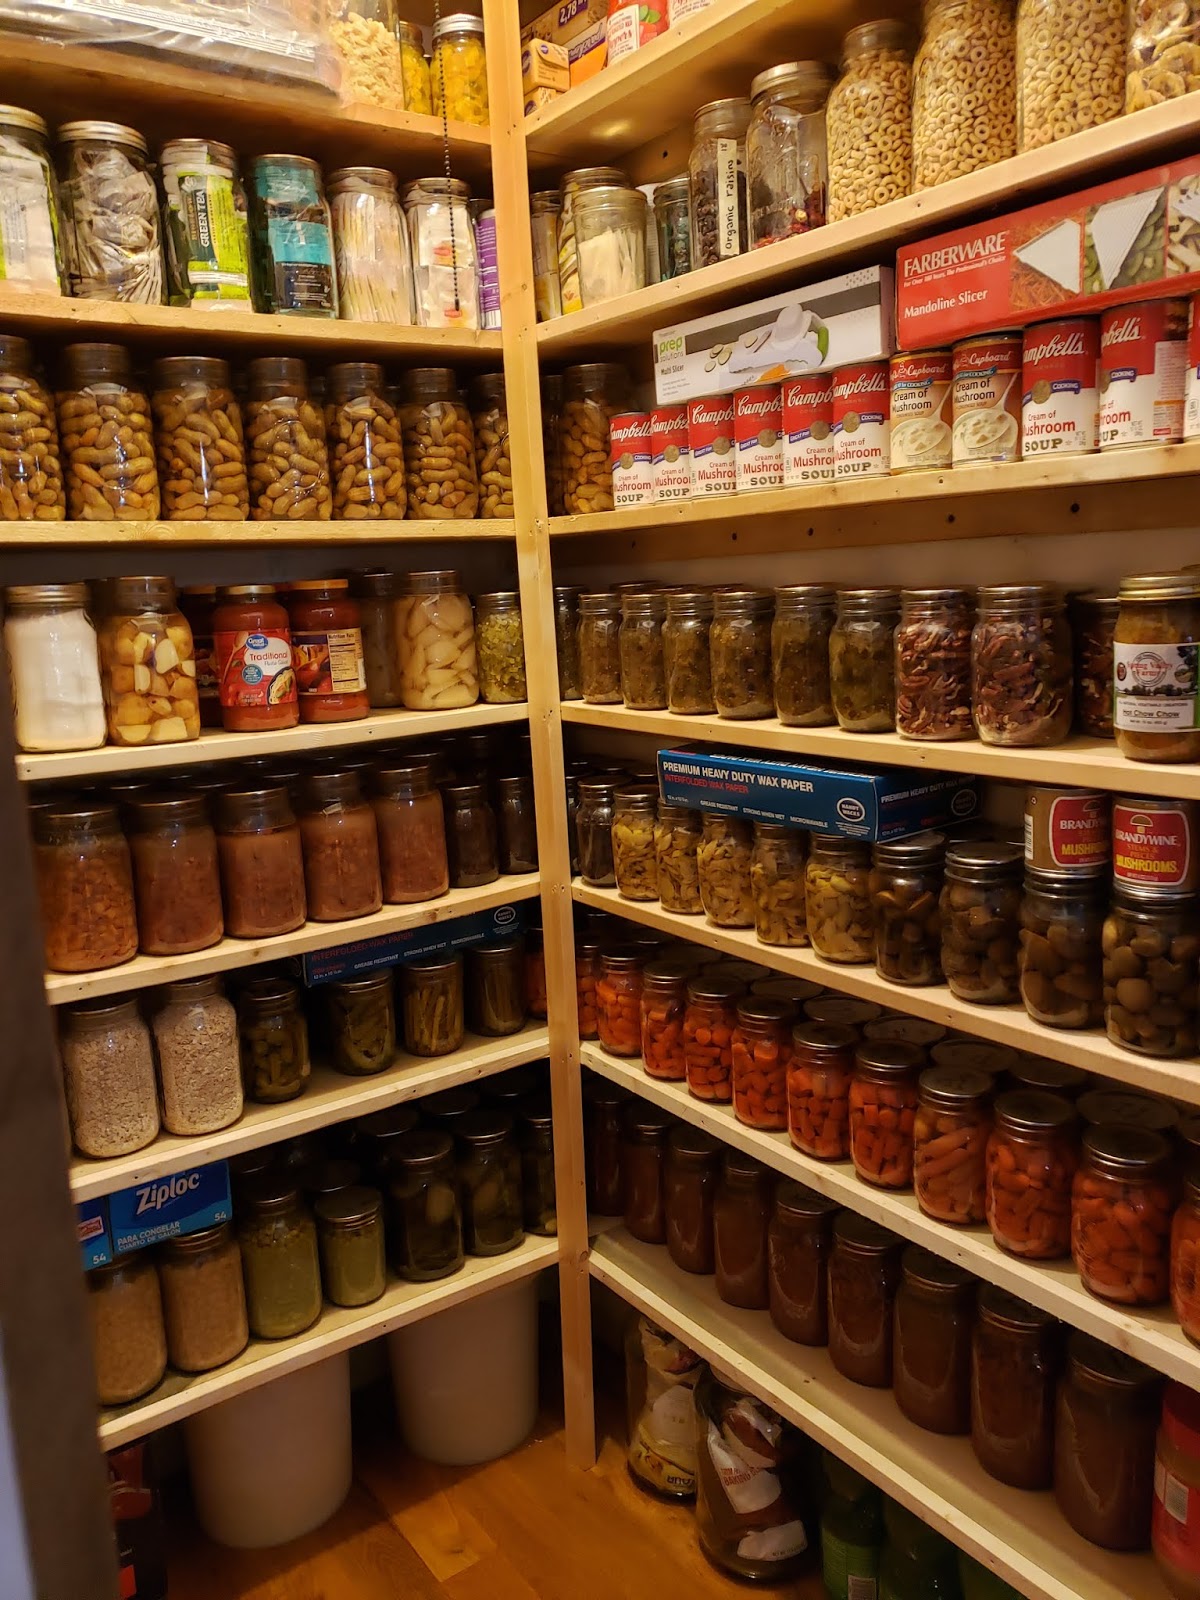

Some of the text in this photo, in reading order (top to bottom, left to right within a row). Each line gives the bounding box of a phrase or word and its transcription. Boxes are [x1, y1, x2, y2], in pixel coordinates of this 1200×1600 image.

[560, 0, 577, 24] 2,78
[196, 189, 210, 247] GREEN TEA
[725, 205, 736, 250] Organic
[904, 232, 1006, 277] FARBERWARE
[904, 290, 988, 318] Mandoline Slicer
[660, 336, 683, 355] prep
[1023, 333, 1085, 365] ampbell's
[970, 351, 1011, 366] Cupboard
[907, 363, 946, 377] Cupboard
[956, 378, 990, 392] Cream of
[788, 385, 834, 407] Campb
[894, 388, 928, 402] Cream of
[1028, 410, 1056, 421] Cream of
[840, 439, 856, 447] Cream
[1025, 438, 1063, 452] SOUP
[793, 455, 834, 468] Mushro
[838, 462, 871, 474] SOUP
[655, 475, 690, 486] Mushroo
[801, 470, 834, 479] SOU
[617, 494, 644, 503] SOUP
[659, 488, 689, 497] SOUP
[250, 652, 287, 661] Traditional
[663, 761, 813, 792] PREMIUM HEAVY DUTY WAX PAPER
[665, 774, 748, 793] INTERFOLDED WAX PAPER
[881, 791, 909, 804] PREMIUM
[910, 786, 928, 796] HEAVY
[1115, 829, 1178, 846] BRANDYWINE
[1116, 853, 1177, 872] MUSHROOMS
[135, 1172, 200, 1216] Ziploc
[214, 1211, 227, 1221] 54
[118, 1220, 180, 1245] PARA CONGELAR
[118, 1238, 145, 1251] CUARTO
[93, 1253, 106, 1264] 54
